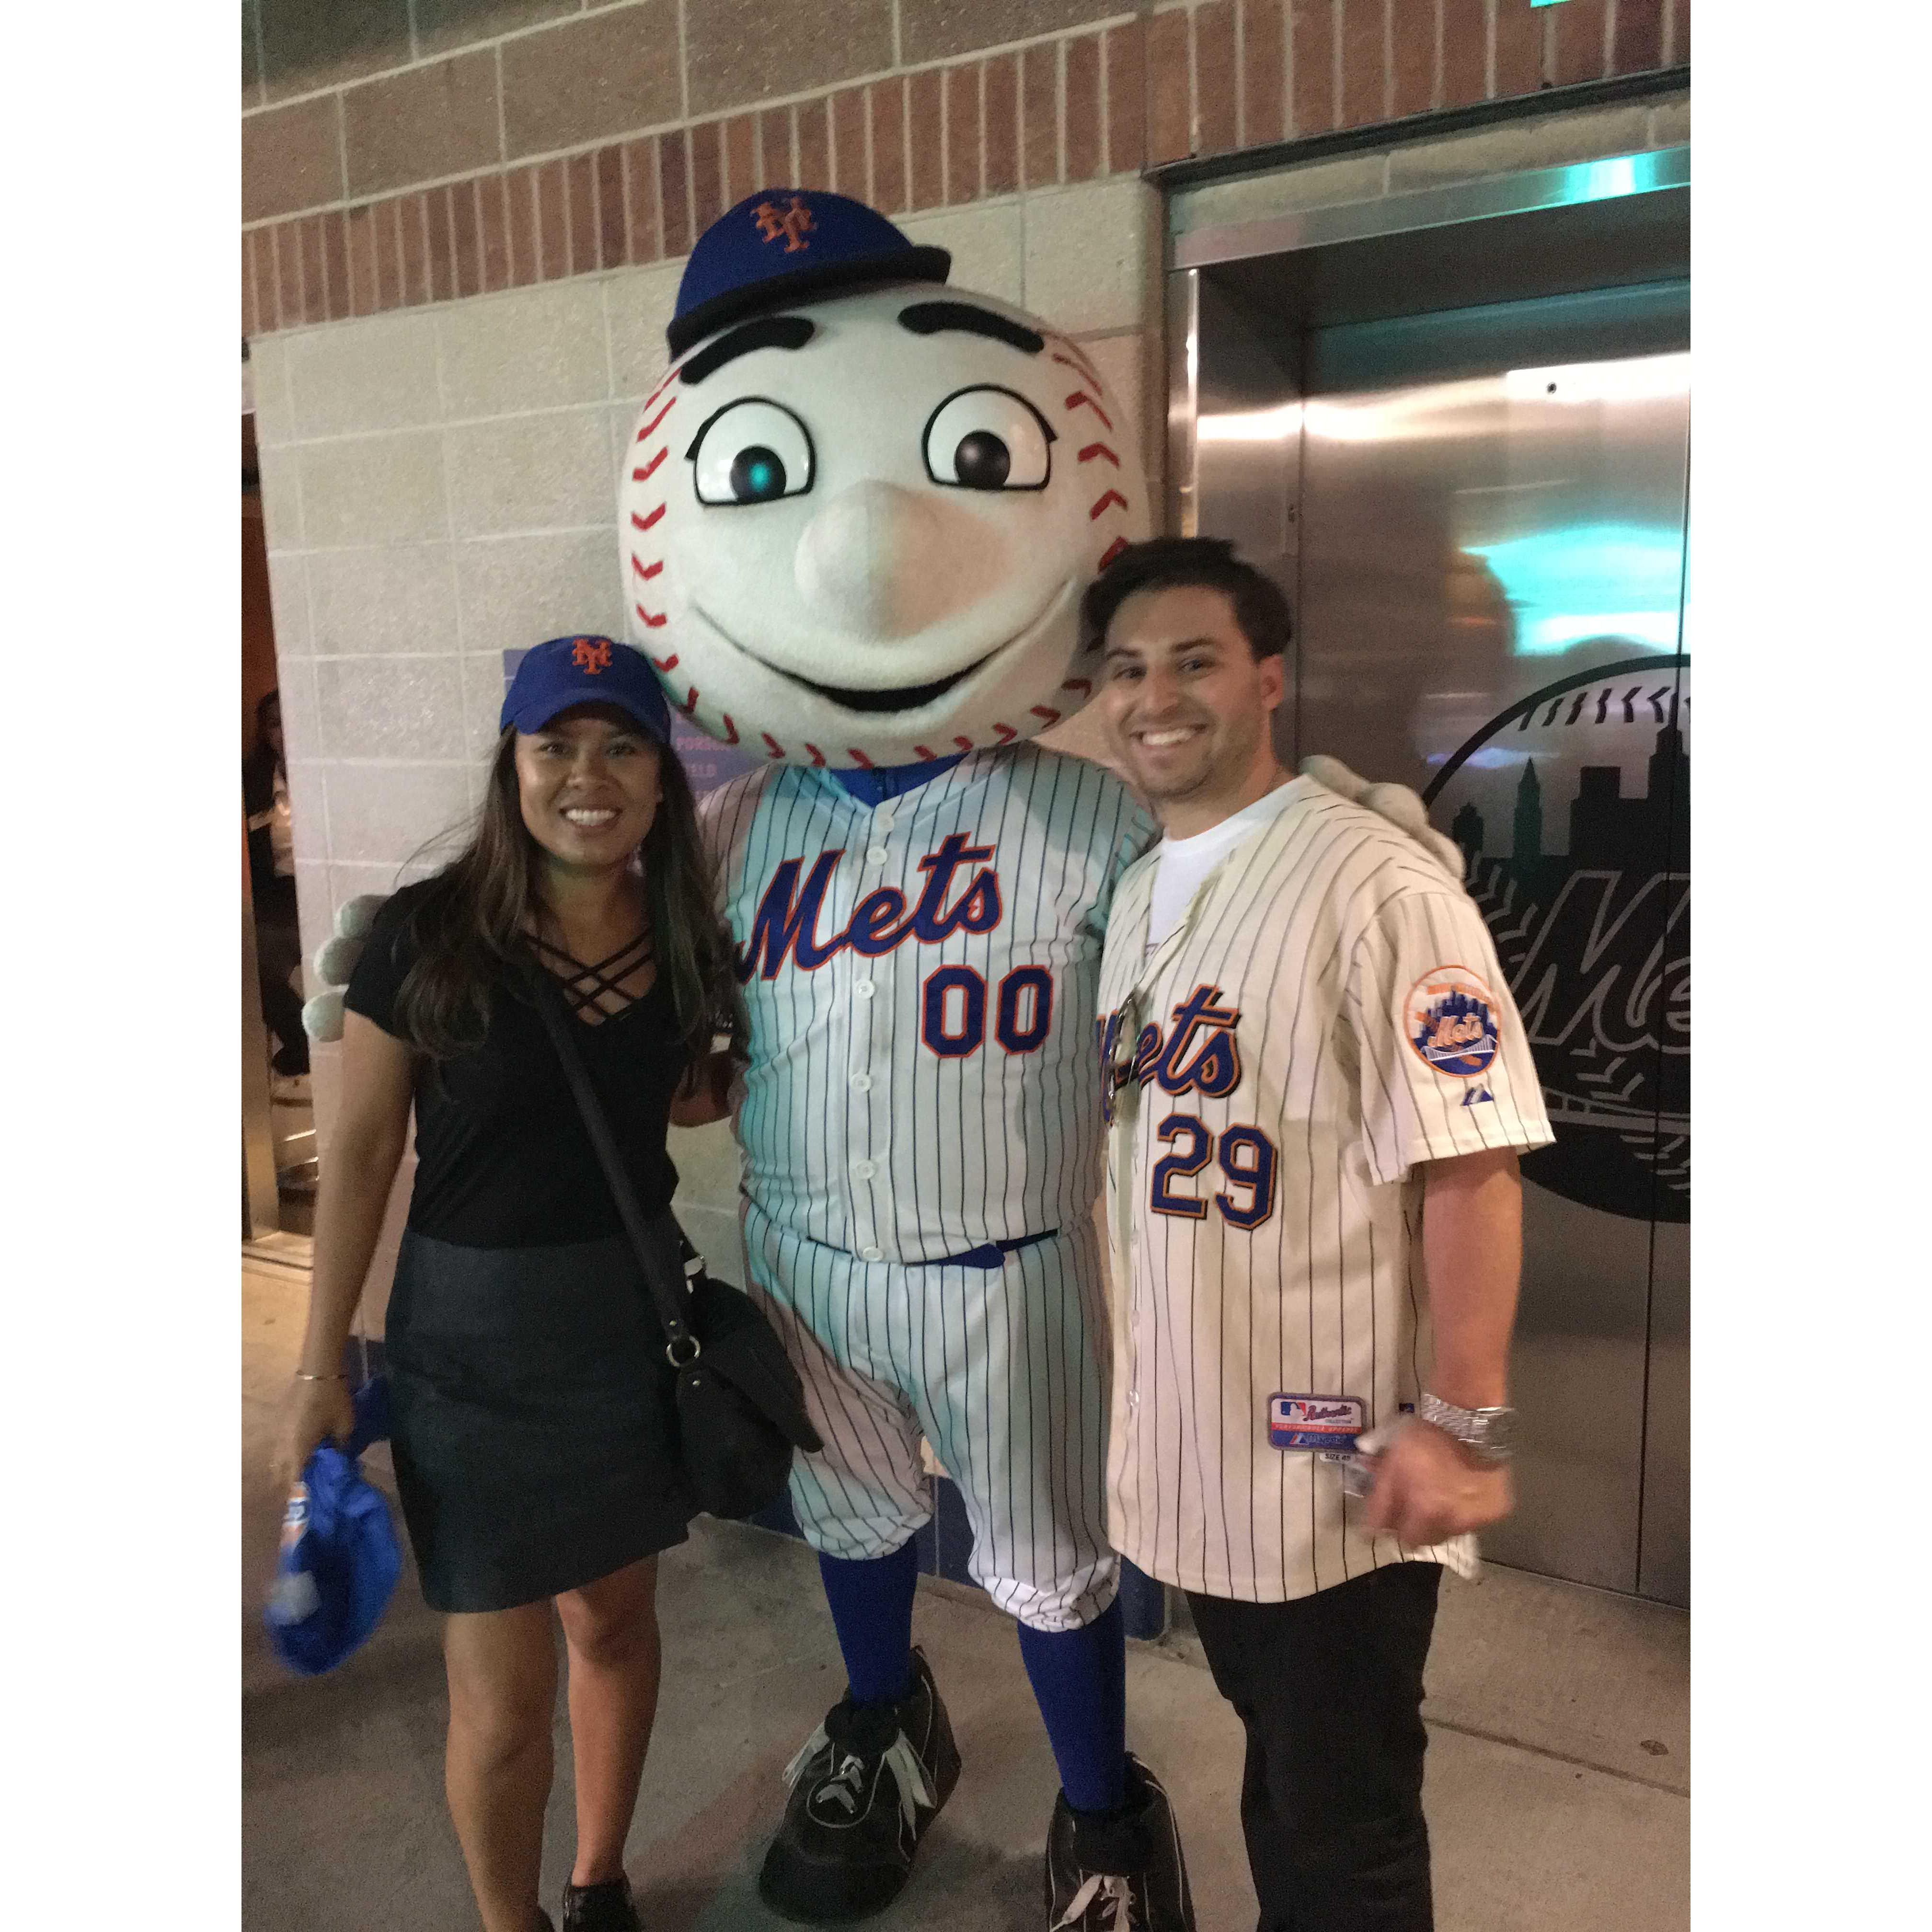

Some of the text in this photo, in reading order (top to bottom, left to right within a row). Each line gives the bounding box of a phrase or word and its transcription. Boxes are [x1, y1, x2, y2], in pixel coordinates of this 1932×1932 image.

[735, 831, 1003, 986] Mets
[921, 964, 1053, 1058] 00
[1427, 1012, 1484, 1047] Mets
[1150, 1112, 1278, 1231] 29
